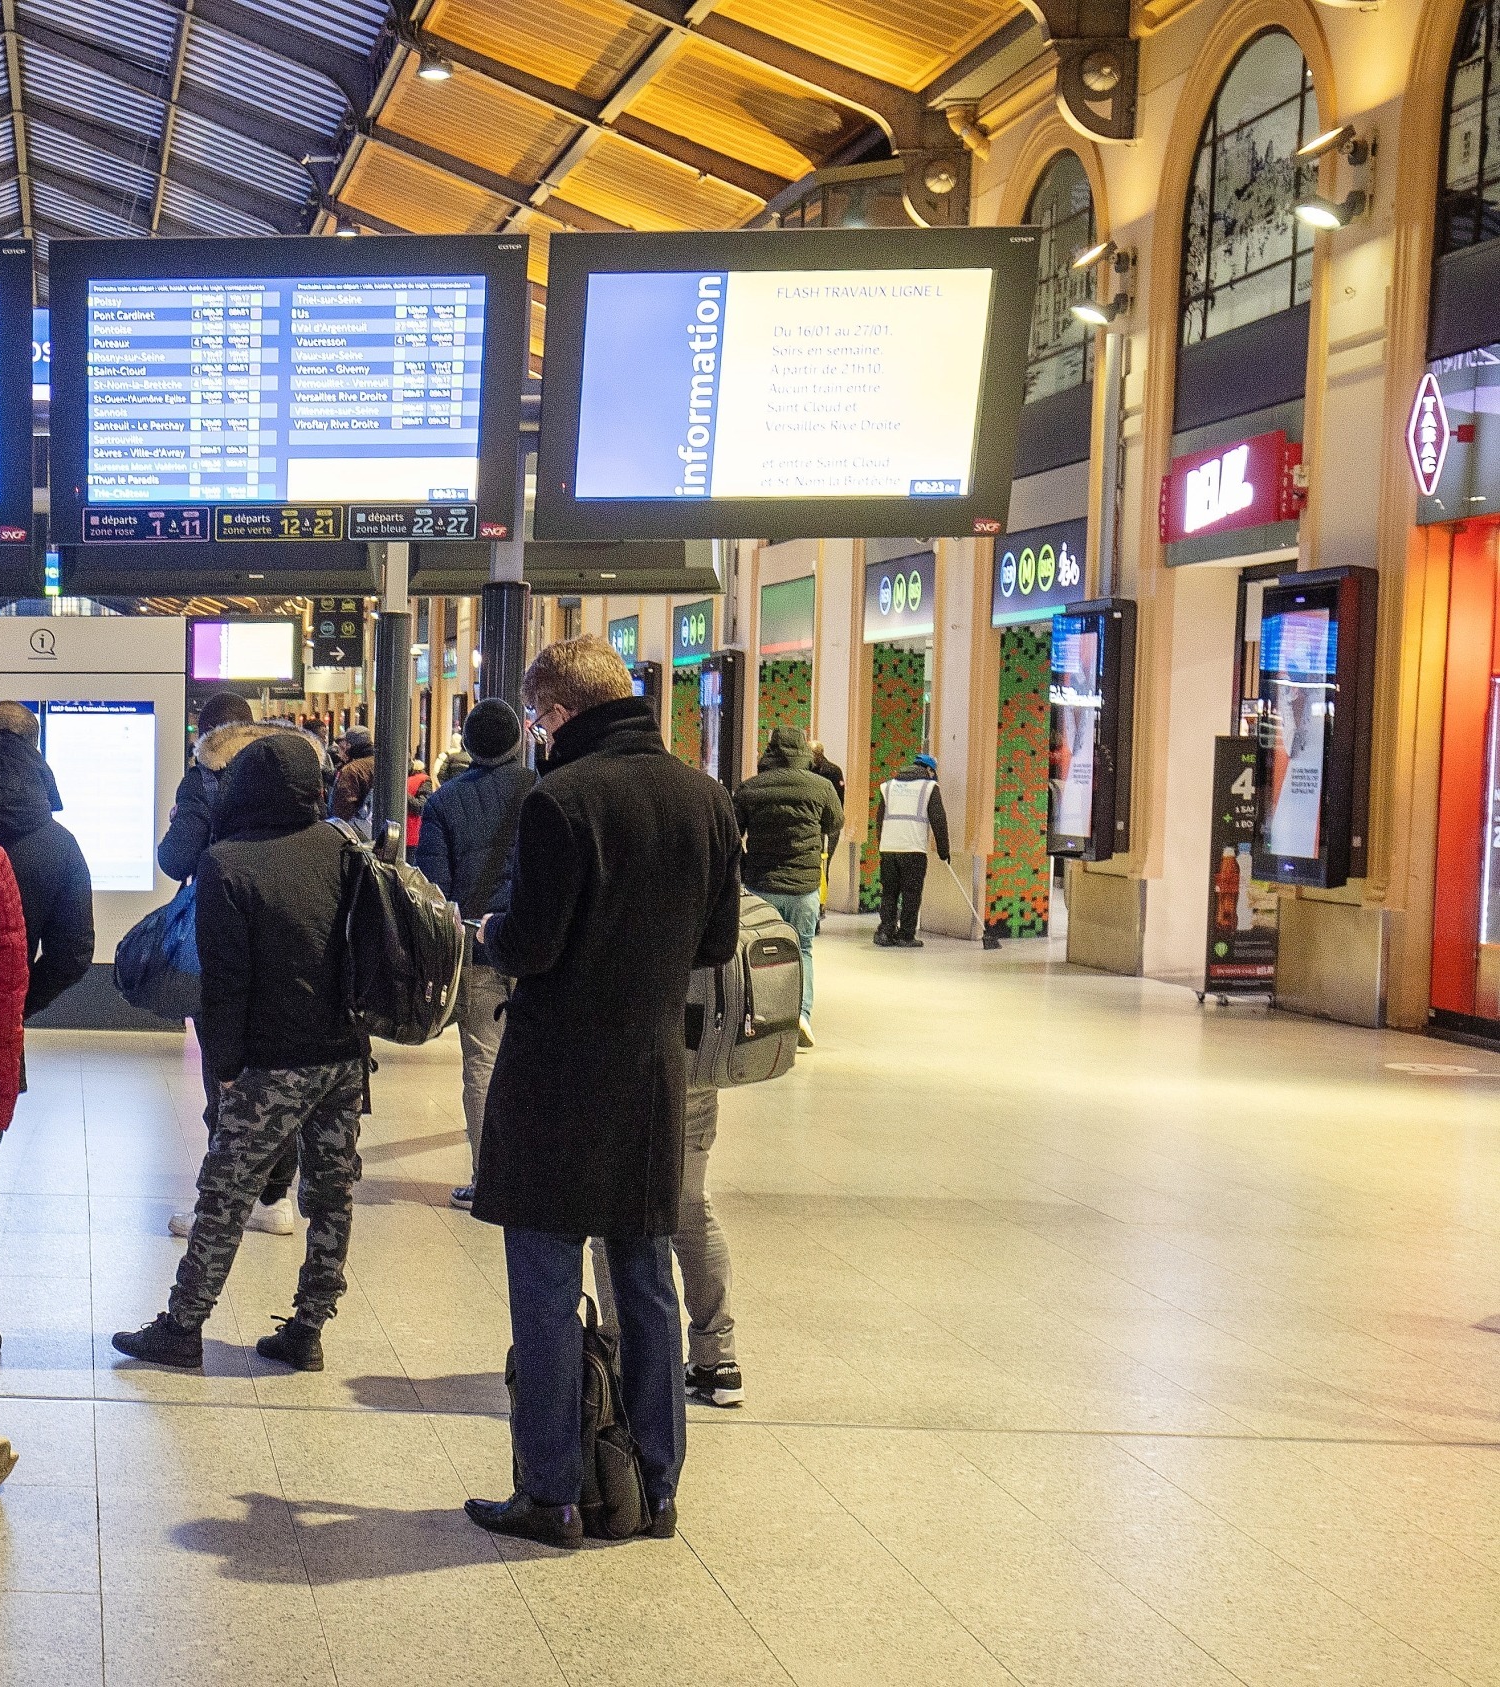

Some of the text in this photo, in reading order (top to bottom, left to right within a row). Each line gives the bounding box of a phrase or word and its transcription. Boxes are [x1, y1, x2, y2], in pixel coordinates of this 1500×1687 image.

[777, 286, 943, 298] FLASH TRAVAUX LIGNE L
[93, 297, 122, 308] Poissy
[93, 310, 156, 321] Pont Cardinet
[297, 309, 310, 319] Us
[93, 324, 133, 335] Pontoise
[774, 326, 792, 337] Du
[798, 325, 830, 338] 16/01
[835, 328, 850, 336] au
[93, 338, 130, 349] Puteaux
[296, 336, 347, 347] Vaucresson
[772, 345, 803, 356] Soirs
[807, 348, 822, 356] en
[93, 365, 147, 377] Saint-Cloud
[783, 365, 816, 377] partir
[822, 364, 837, 374] de
[674, 276, 722, 495] information
[770, 383, 881, 394] Aucun train entre
[294, 391, 388, 402] Versailles Rive Droite
[767, 402, 857, 412] Saint Cloud et
[293, 418, 380, 431] Viroflay Rive Droite
[765, 420, 900, 431] Versailles Rive Droite
[1421, 395, 1438, 474] TABAC
[852, 457, 890, 467] Cloud
[102, 515, 138, 526] départs
[235, 514, 271, 525] départs
[368, 512, 404, 523] départs
[152, 520, 200, 536] 1 11
[280, 518, 334, 535] 12 21
[356, 524, 407, 533] zone bleue
[412, 517, 469, 533] 22 27
[1, 531, 26, 540] SNCF
[90, 528, 135, 536] zone rose
[223, 527, 272, 535] zone verte
[481, 527, 506, 537] SNCF
[1231, 767, 1256, 800] 4
